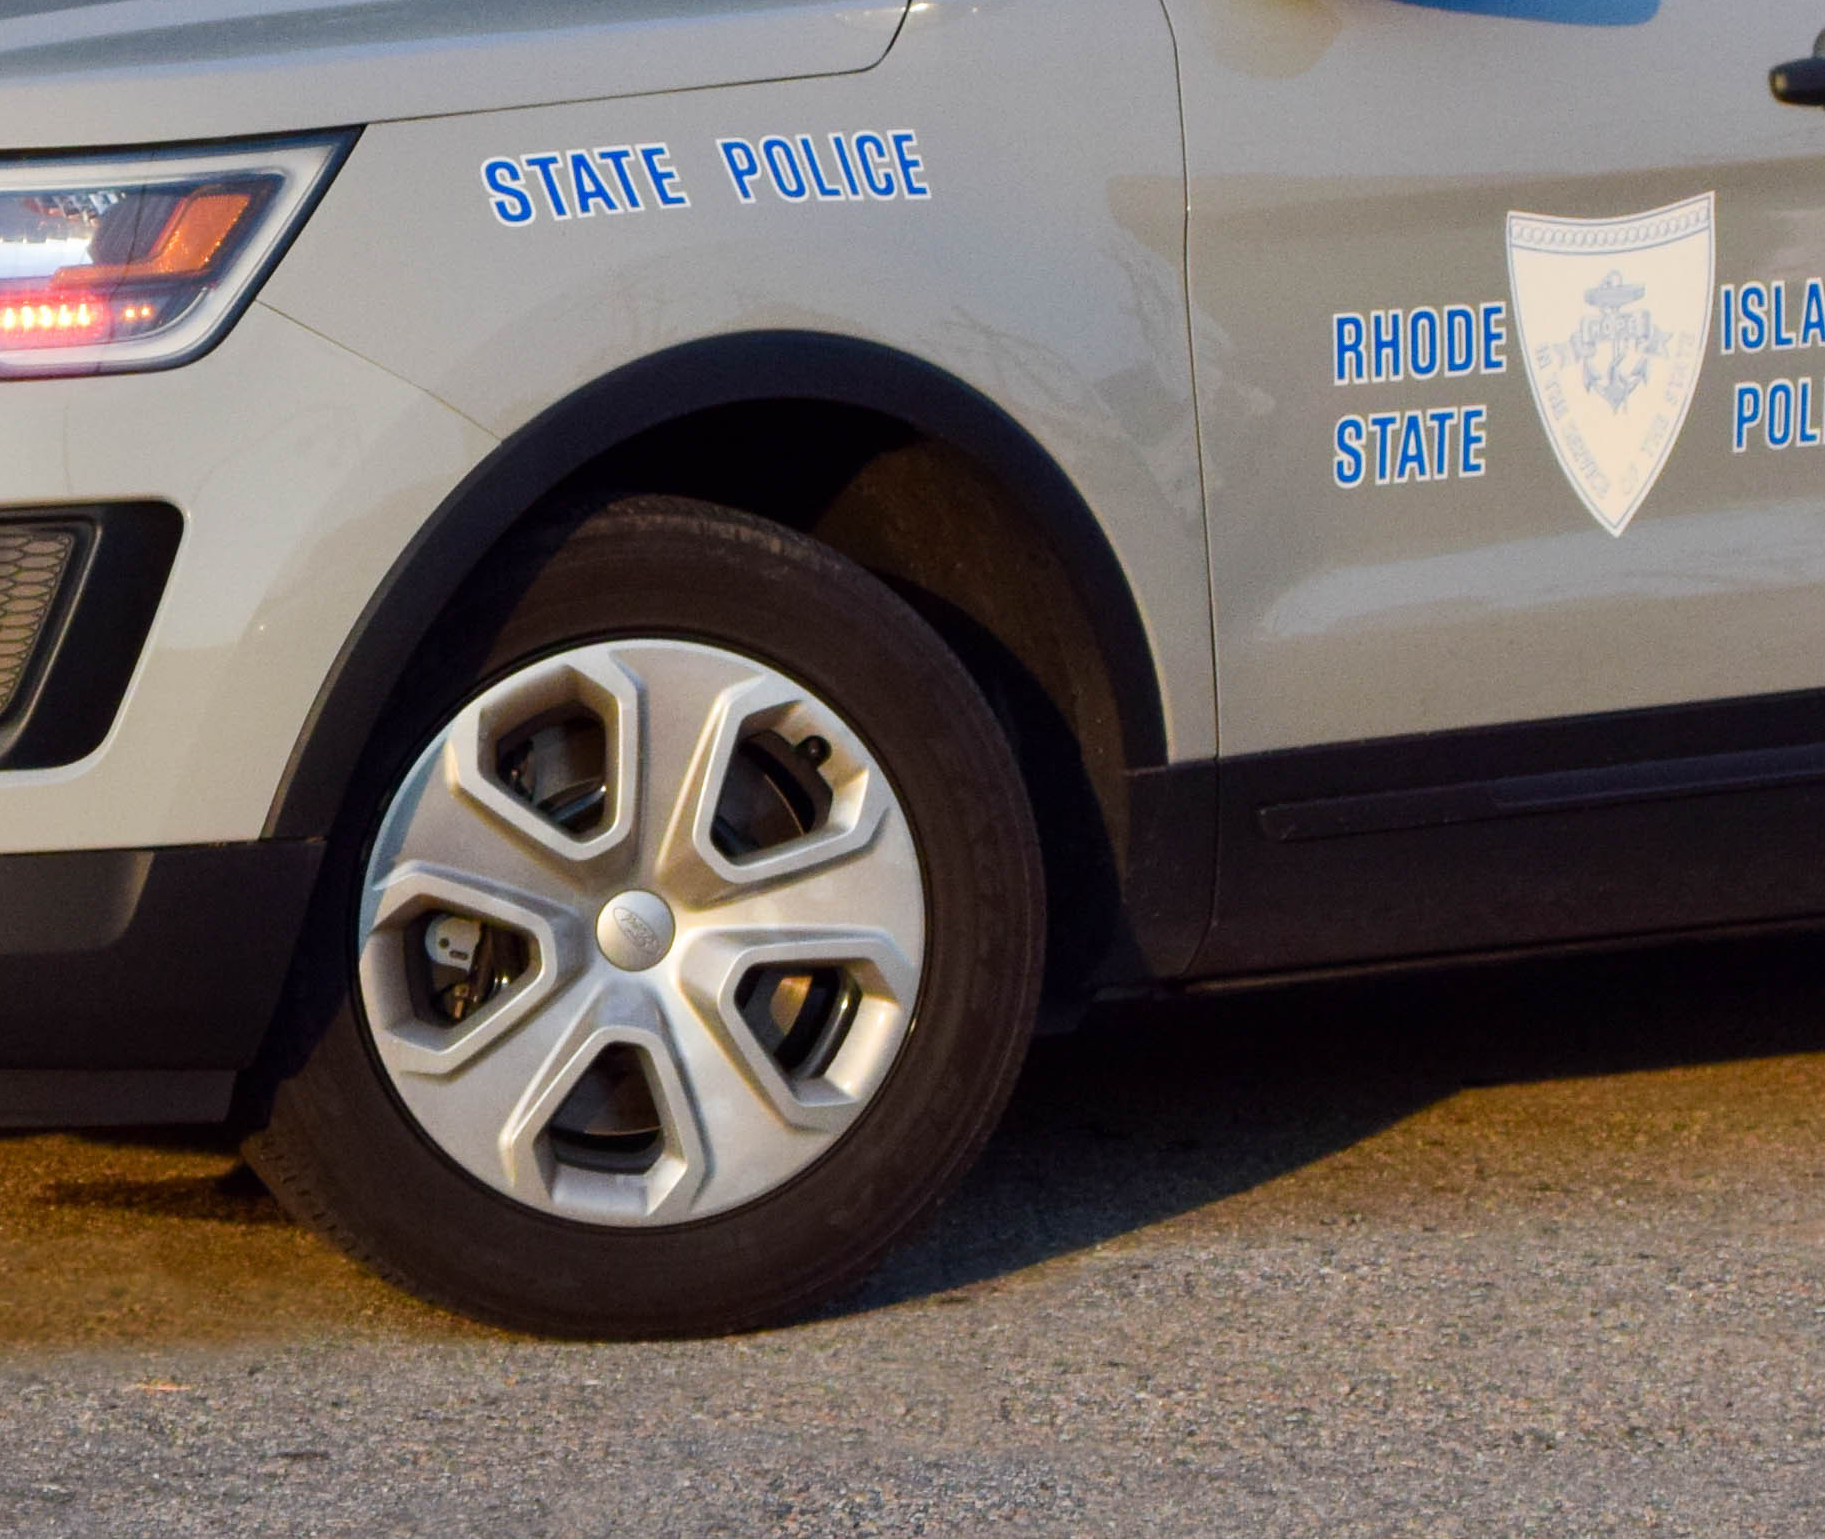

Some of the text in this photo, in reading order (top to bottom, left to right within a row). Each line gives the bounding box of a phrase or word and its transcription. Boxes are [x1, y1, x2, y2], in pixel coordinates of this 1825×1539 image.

[480, 129, 932, 228] STATE POLICE
[1333, 301, 1508, 386] RHODE
[1333, 405, 1487, 490] STATE
